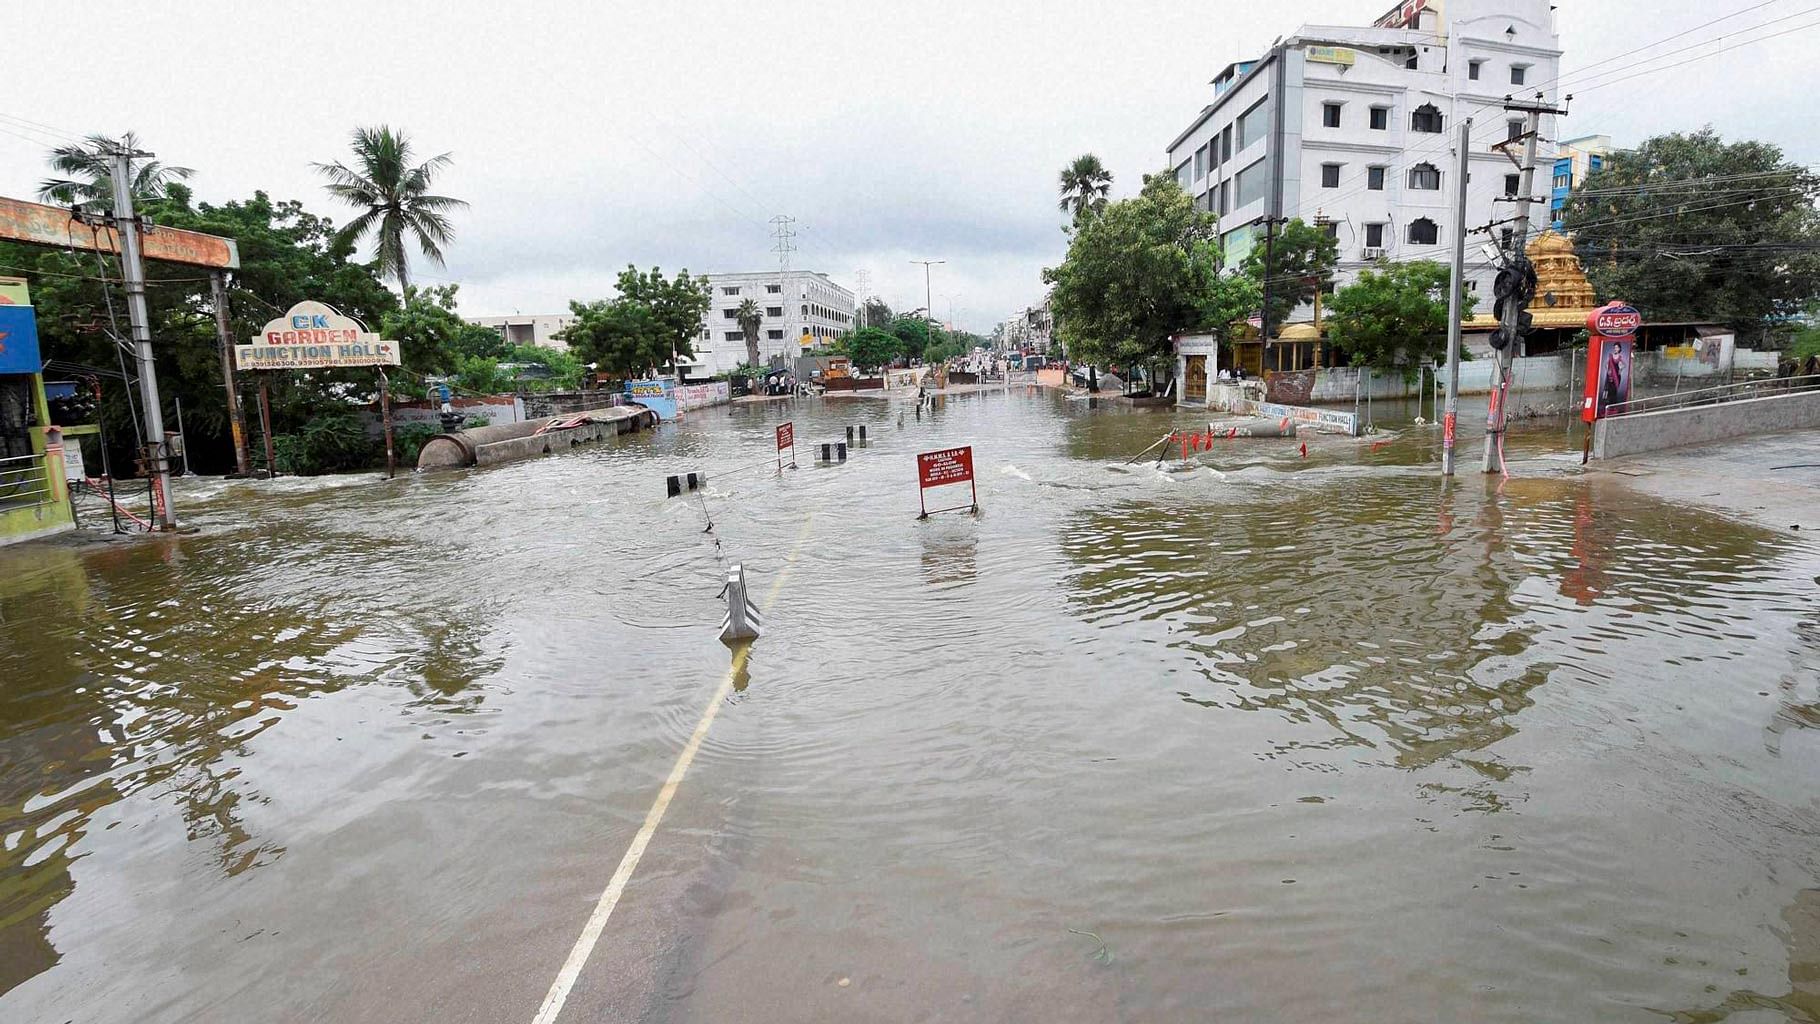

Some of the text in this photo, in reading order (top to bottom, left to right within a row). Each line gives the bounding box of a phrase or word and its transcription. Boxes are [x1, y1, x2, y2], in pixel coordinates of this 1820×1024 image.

[292, 314, 329, 329] CK
[267, 329, 357, 345] GARDEN
[240, 342, 387, 361] FUNCTION HALL
